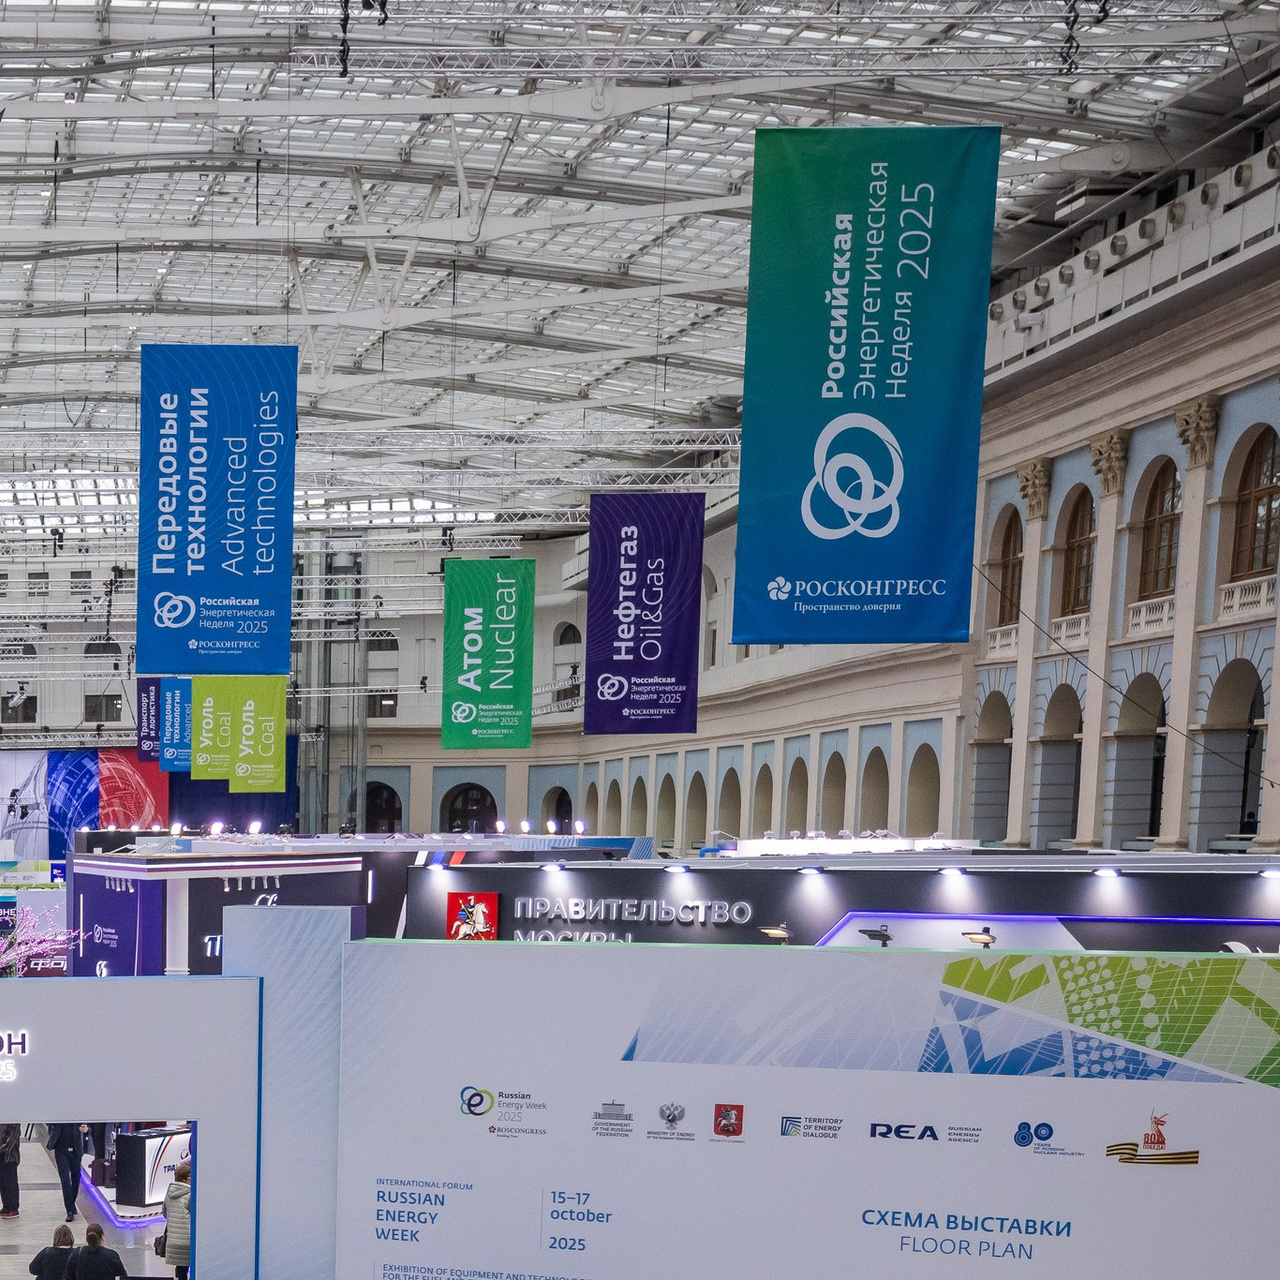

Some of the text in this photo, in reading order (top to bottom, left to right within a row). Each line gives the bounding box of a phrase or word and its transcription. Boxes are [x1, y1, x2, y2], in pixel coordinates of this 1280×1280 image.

[854, 161, 889, 399] Энергетическая
[885, 182, 934, 398] Неделя 2025
[822, 213, 853, 399] Российская
[152, 393, 182, 574] Передовые
[186, 388, 208, 576] технологии
[251, 390, 283, 575] technologies
[221, 437, 247, 576] Advanced
[613, 525, 641, 661] Нефтегаз
[795, 579, 946, 597] РОСКОНГРЕСС
[200, 597, 259, 606] Российская
[200, 608, 275, 618] Энергетическая
[640, 558, 664, 661] Oil&Gas
[794, 602, 901, 612] Пространство доверия
[200, 619, 268, 633] Неделя 2025
[490, 573, 516, 689] Nuclear
[199, 640, 260, 648] РОСКОНГРЕСС
[458, 608, 483, 692] Атом
[631, 693, 682, 703] Неделя 2025
[141, 693, 149, 737] Транспорт
[164, 692, 173, 743] Передовые
[200, 697, 213, 748] Уголь
[217, 712, 231, 747] Coal
[239, 700, 255, 757] Уголь
[258, 717, 274, 757] Coal
[514, 897, 752, 924] ПРАВИТЕЛЬСТВО
[498, 1101, 523, 1110] Energy
[498, 1111, 522, 1121] 2025
[497, 1127, 546, 1135] ROSCONGRESS
[871, 1123, 939, 1140] REA
[376, 1178, 473, 1190] INTERNATIONAL FORUM
[377, 1190, 445, 1206] RUSSIAN
[376, 1209, 438, 1224] ENERGY
[550, 1208, 612, 1223] october
[862, 1209, 1071, 1237] СХЕМА ВЫСТАВКИ
[375, 1228, 420, 1242] WEEK
[549, 1236, 586, 1251] 2025
[900, 1236, 1033, 1259] FLOOR PLAN
[383, 1264, 434, 1275] EXHIBITION
[436, 1267, 448, 1275] OF
[450, 1268, 504, 1280] EQUIPMENT
[506, 1272, 526, 1280] AND
[383, 1272, 401, 1280] FOR
